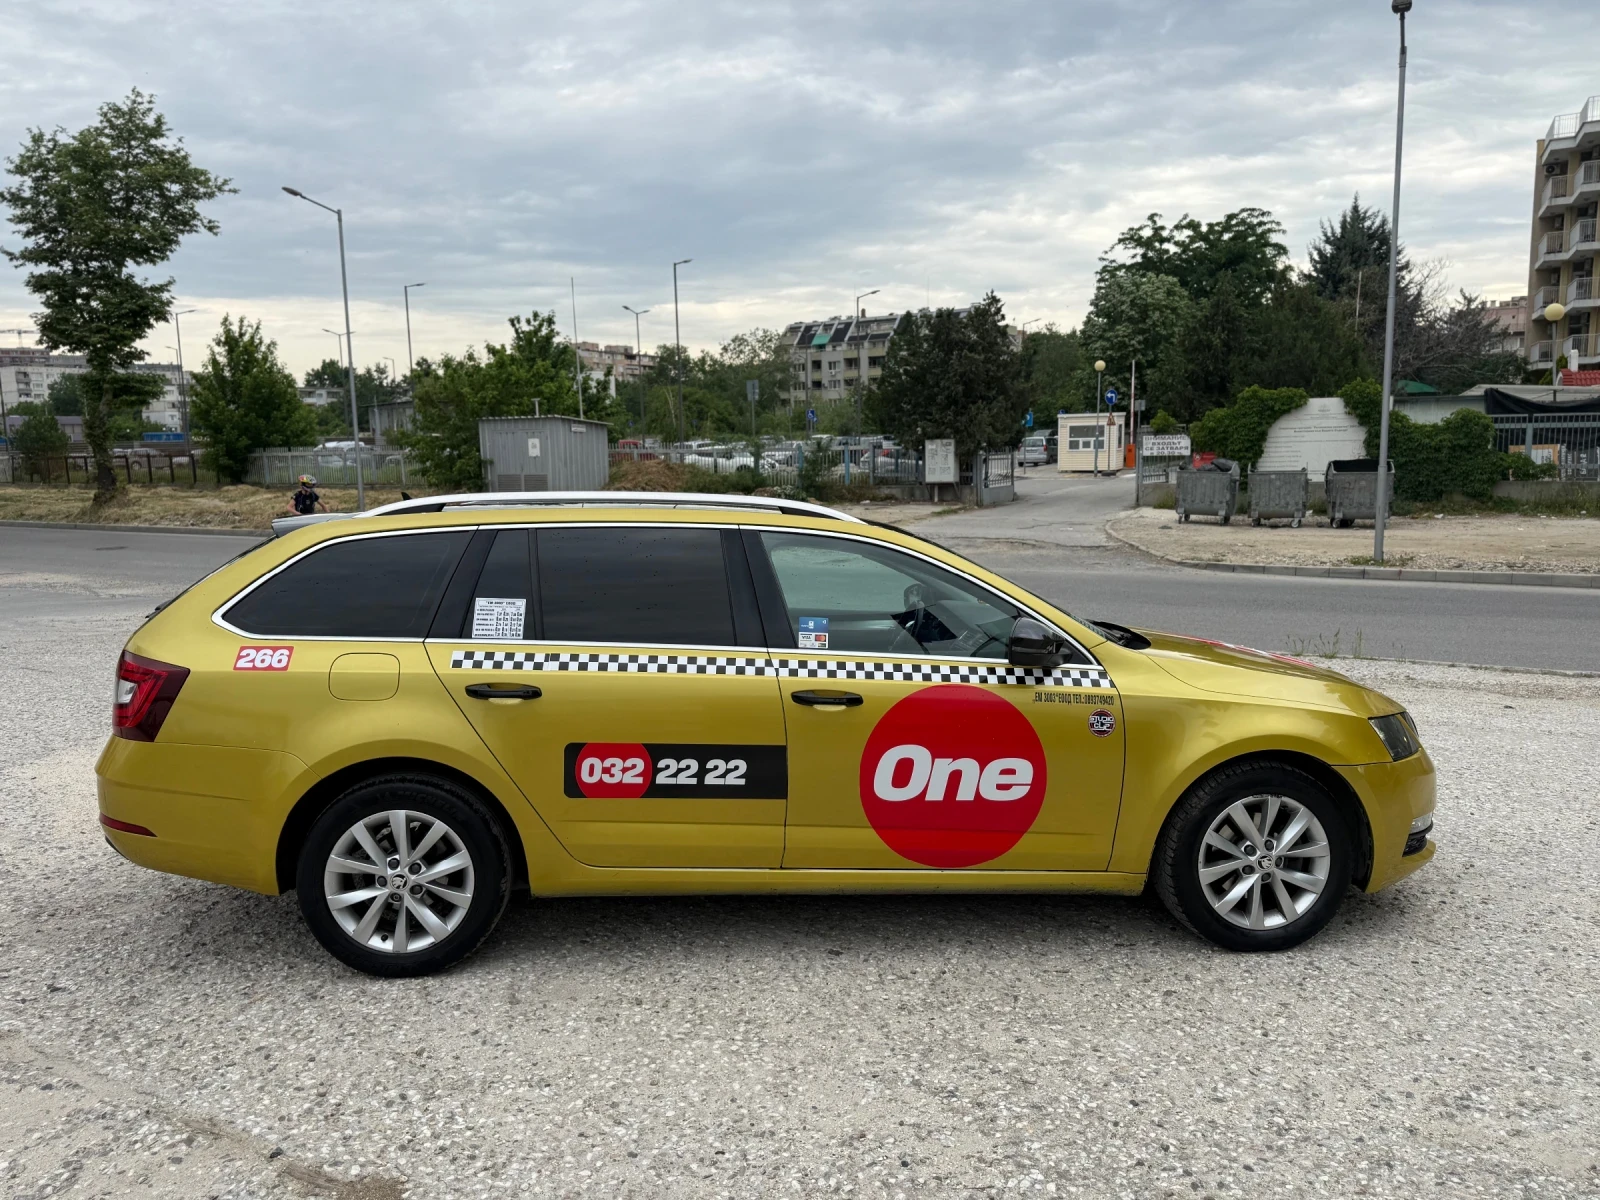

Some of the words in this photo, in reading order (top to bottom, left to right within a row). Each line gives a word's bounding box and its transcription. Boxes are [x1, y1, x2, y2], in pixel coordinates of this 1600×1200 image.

[235, 648, 290, 668] 266
[580, 757, 645, 784] 032
[655, 758, 699, 785] 22
[704, 758, 748, 786] 22
[873, 744, 1034, 802] One
